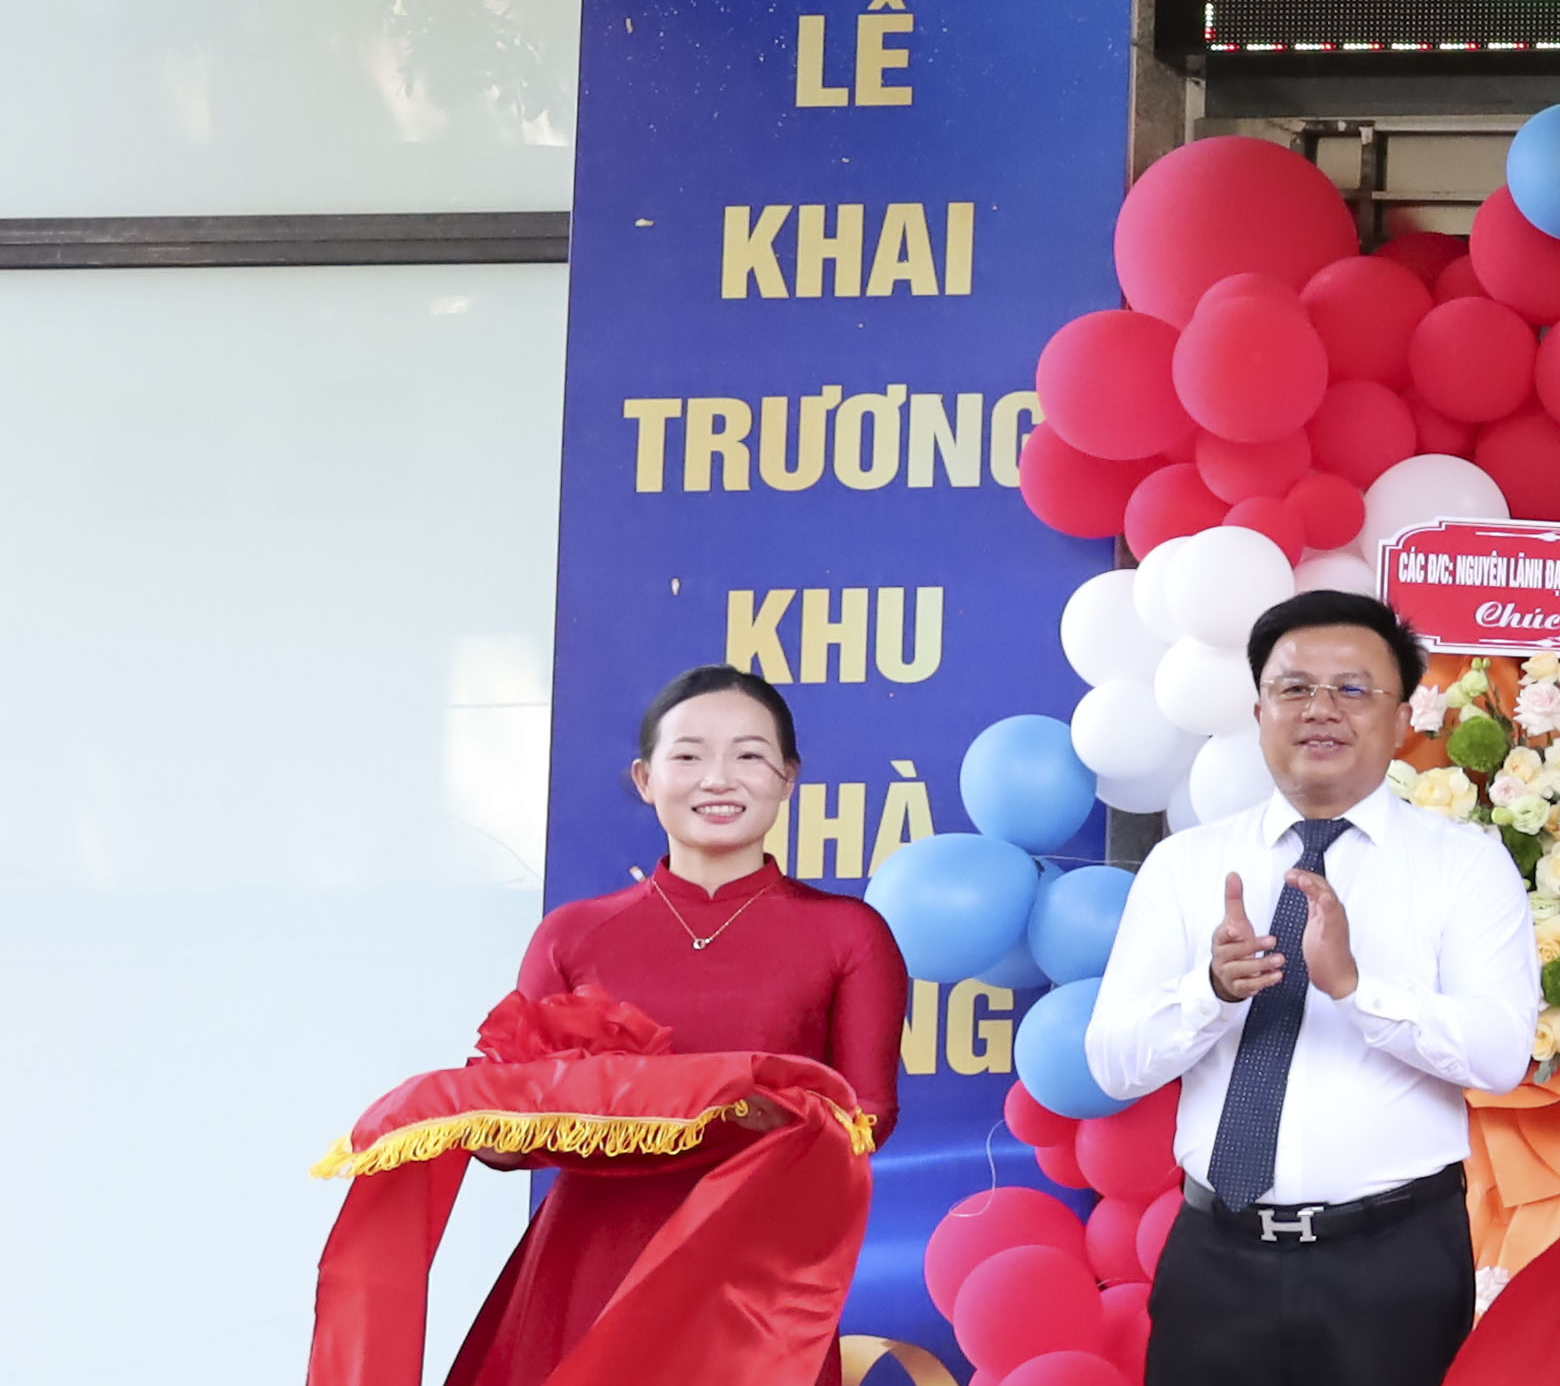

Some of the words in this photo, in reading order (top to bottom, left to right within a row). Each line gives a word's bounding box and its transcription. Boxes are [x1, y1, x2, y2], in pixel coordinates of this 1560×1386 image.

[721, 202, 975, 299] KHAI
[623, 384, 1046, 493] TRƯƠNG
[1398, 546, 1425, 584] CÁC
[1427, 553, 1454, 585] Đ/C:
[1456, 550, 1508, 588] NGUYÊN
[1509, 552, 1544, 589] LÃNH
[725, 586, 944, 684] KHU
